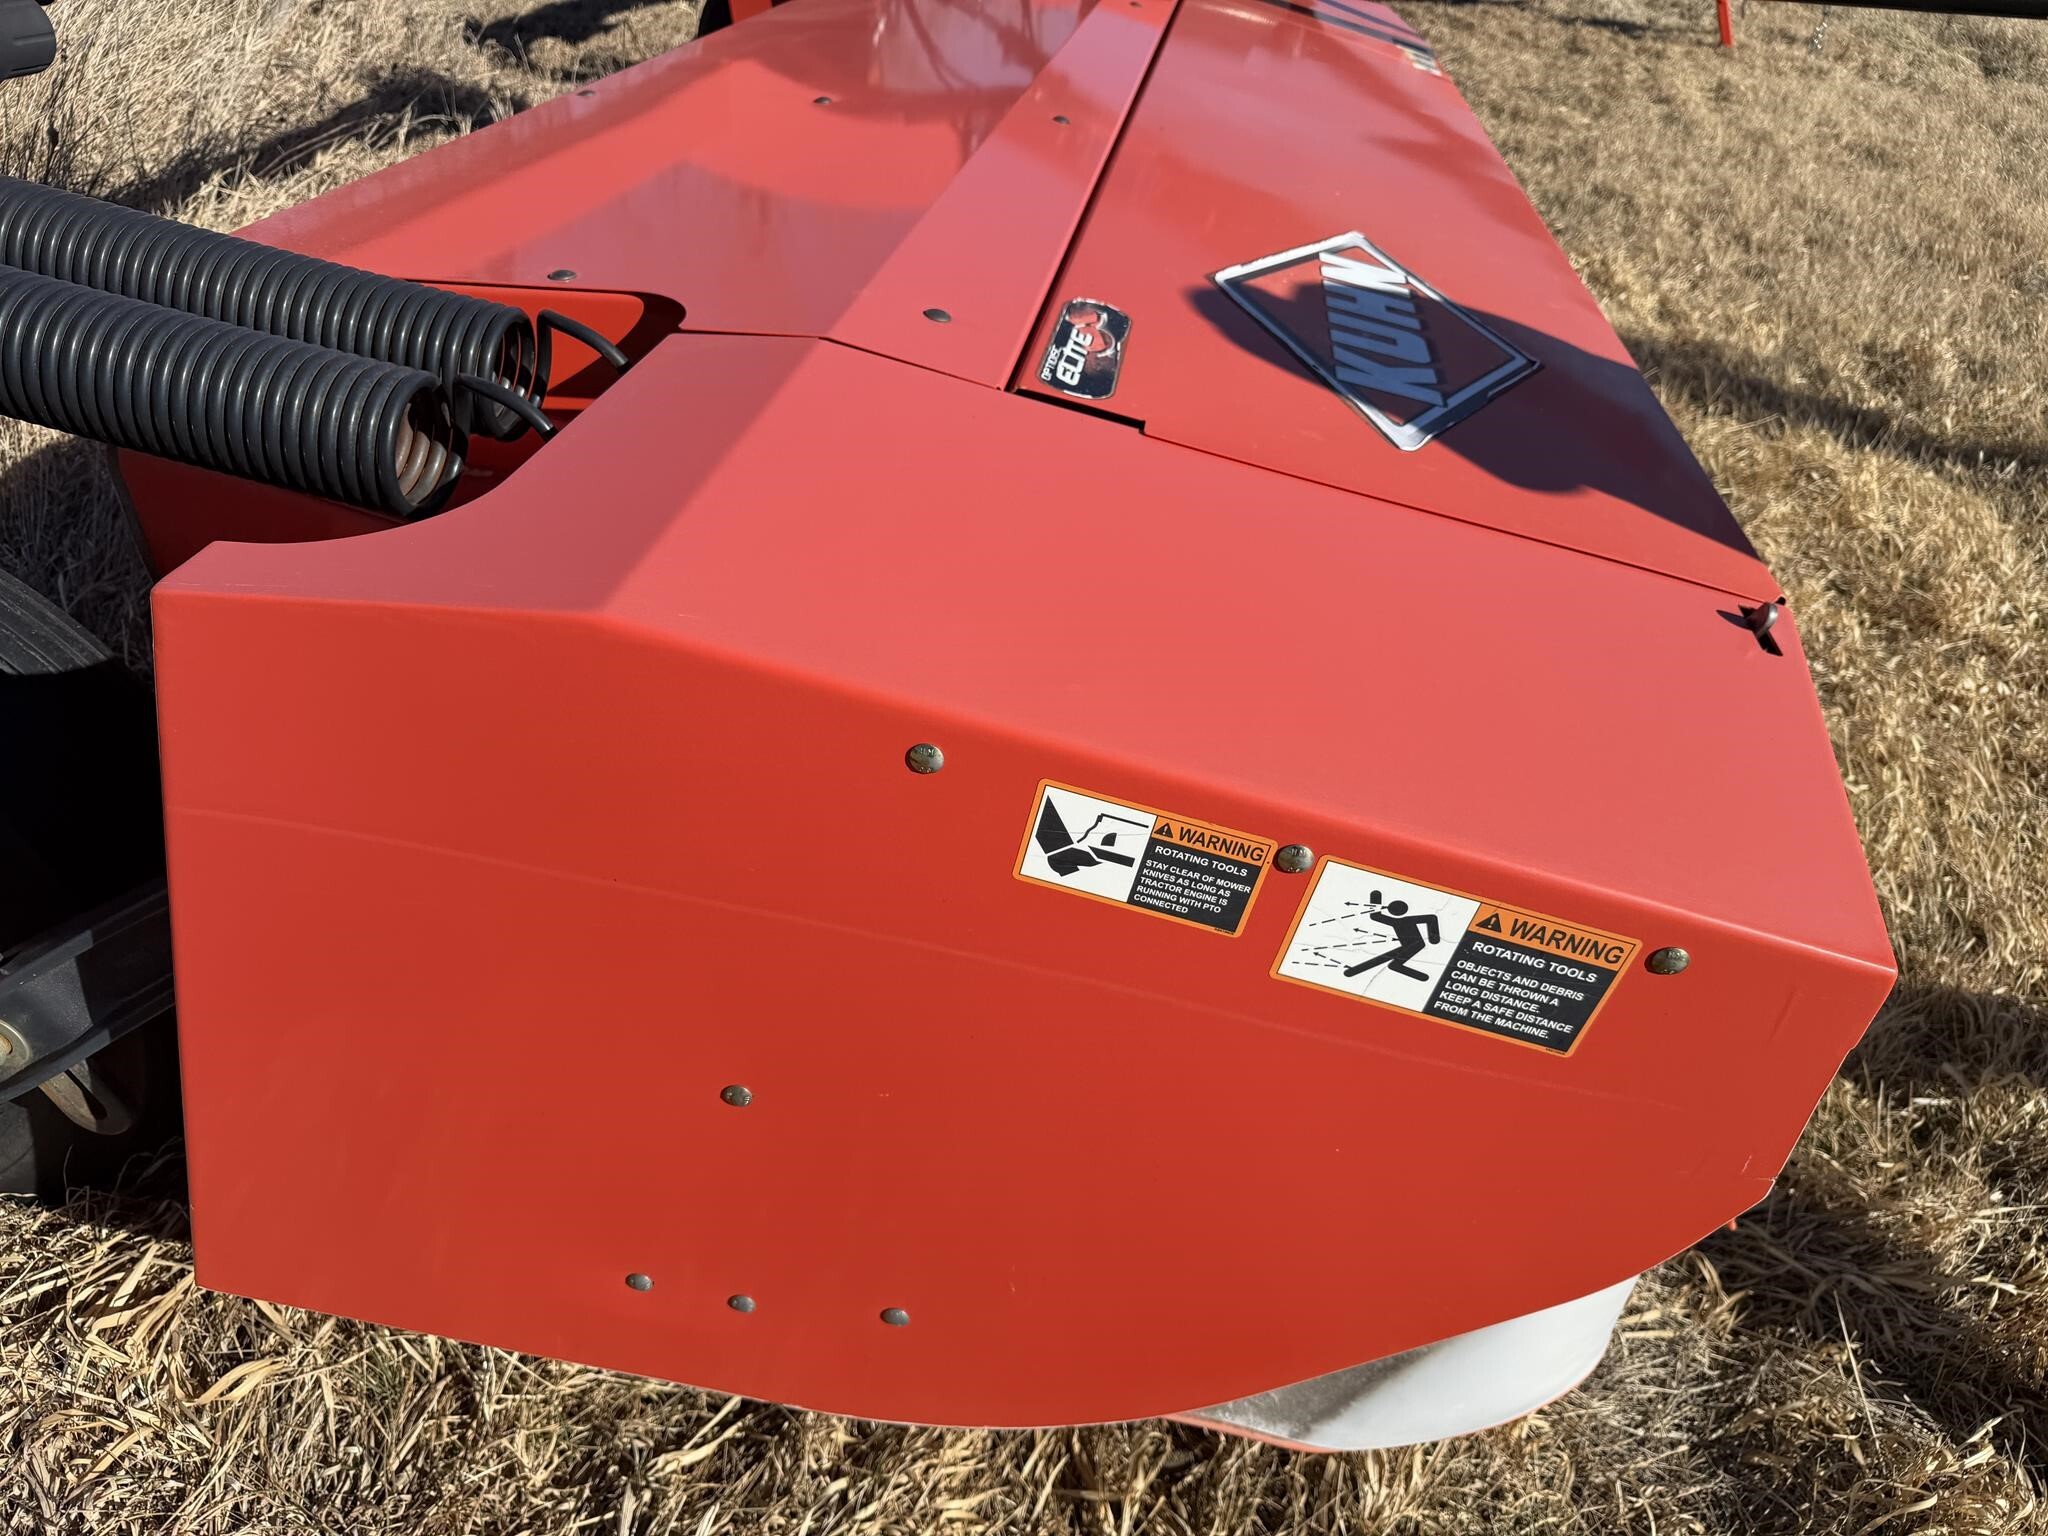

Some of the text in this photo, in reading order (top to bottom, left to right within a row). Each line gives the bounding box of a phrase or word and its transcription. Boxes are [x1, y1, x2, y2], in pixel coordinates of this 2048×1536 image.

[1319, 251, 1448, 408] KUHN
[1056, 327, 1093, 386] ELITE
[1155, 846, 1248, 876] ROTATING TOOLS
[1180, 826, 1264, 861] WARNING
[1140, 877, 1228, 906] TRACTOR ENGINE IS
[1143, 868, 1231, 897] KNIVES AS LONG AS
[1146, 860, 1168, 870] STAY
[1170, 866, 1200, 879] CLEAR
[1216, 879, 1251, 893] MOWER
[1134, 894, 1188, 913] CONNECTED
[1137, 886, 1221, 913] RUNNING WITH PTO
[1509, 918, 1624, 964] WARNING
[1472, 942, 1598, 983] ROTATING TOOLS
[1445, 981, 1540, 1013] LONG DISTANCE.
[1451, 970, 1559, 1006] CAN BE THROWN A
[1456, 960, 1584, 1001] OBJECTS AND DEBRIS
[1434, 1001, 1548, 1039] FROM THE MACHINE.
[1439, 991, 1573, 1034] KEEP A SAFE DISTANCE
